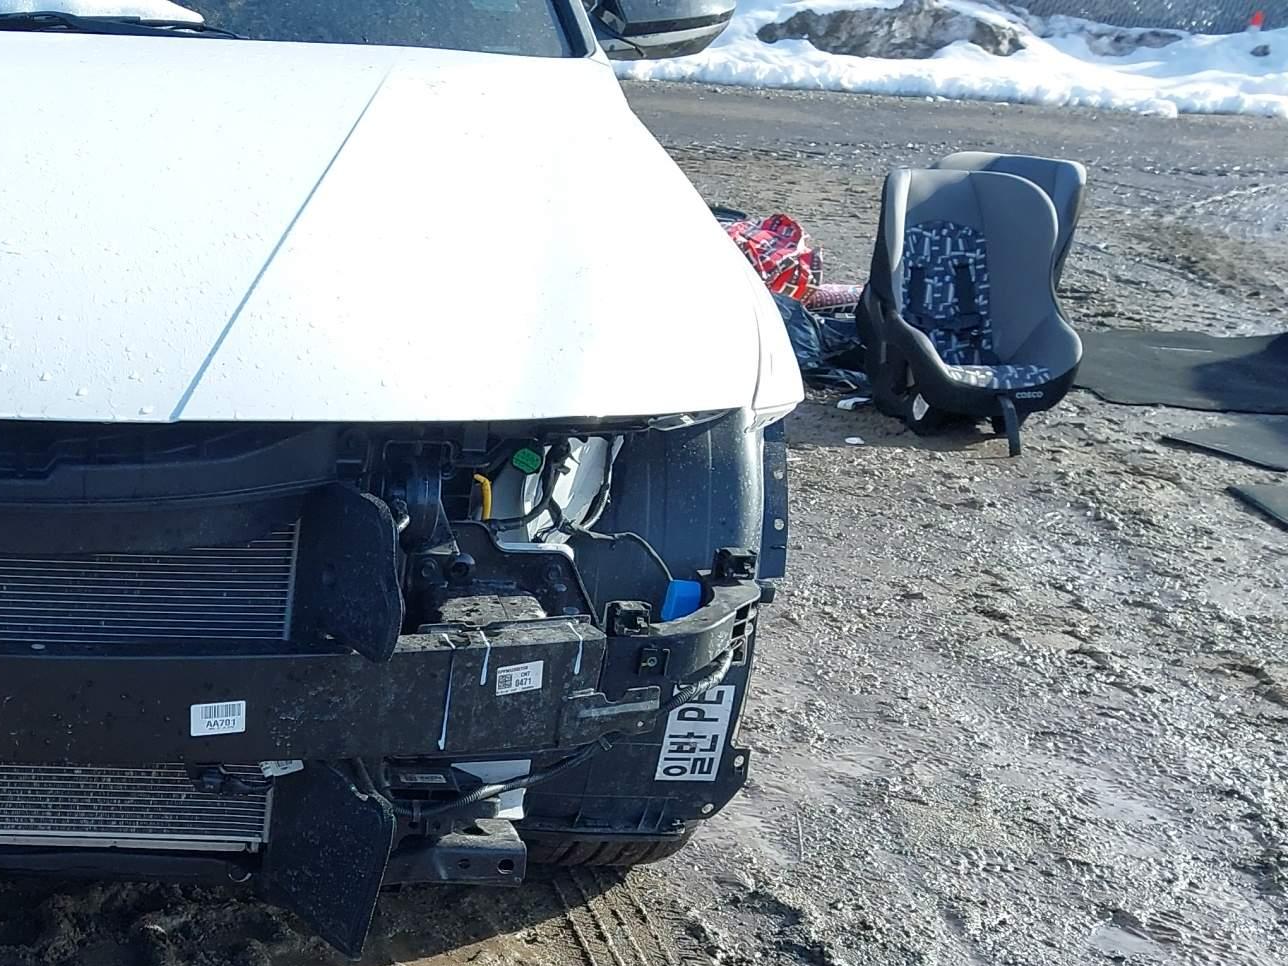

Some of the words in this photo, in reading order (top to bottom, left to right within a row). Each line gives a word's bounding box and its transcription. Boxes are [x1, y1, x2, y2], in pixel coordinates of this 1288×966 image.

[515, 677, 531, 687] 0471
[206, 718, 236, 728] AA701
[662, 731, 719, 776] 일반
